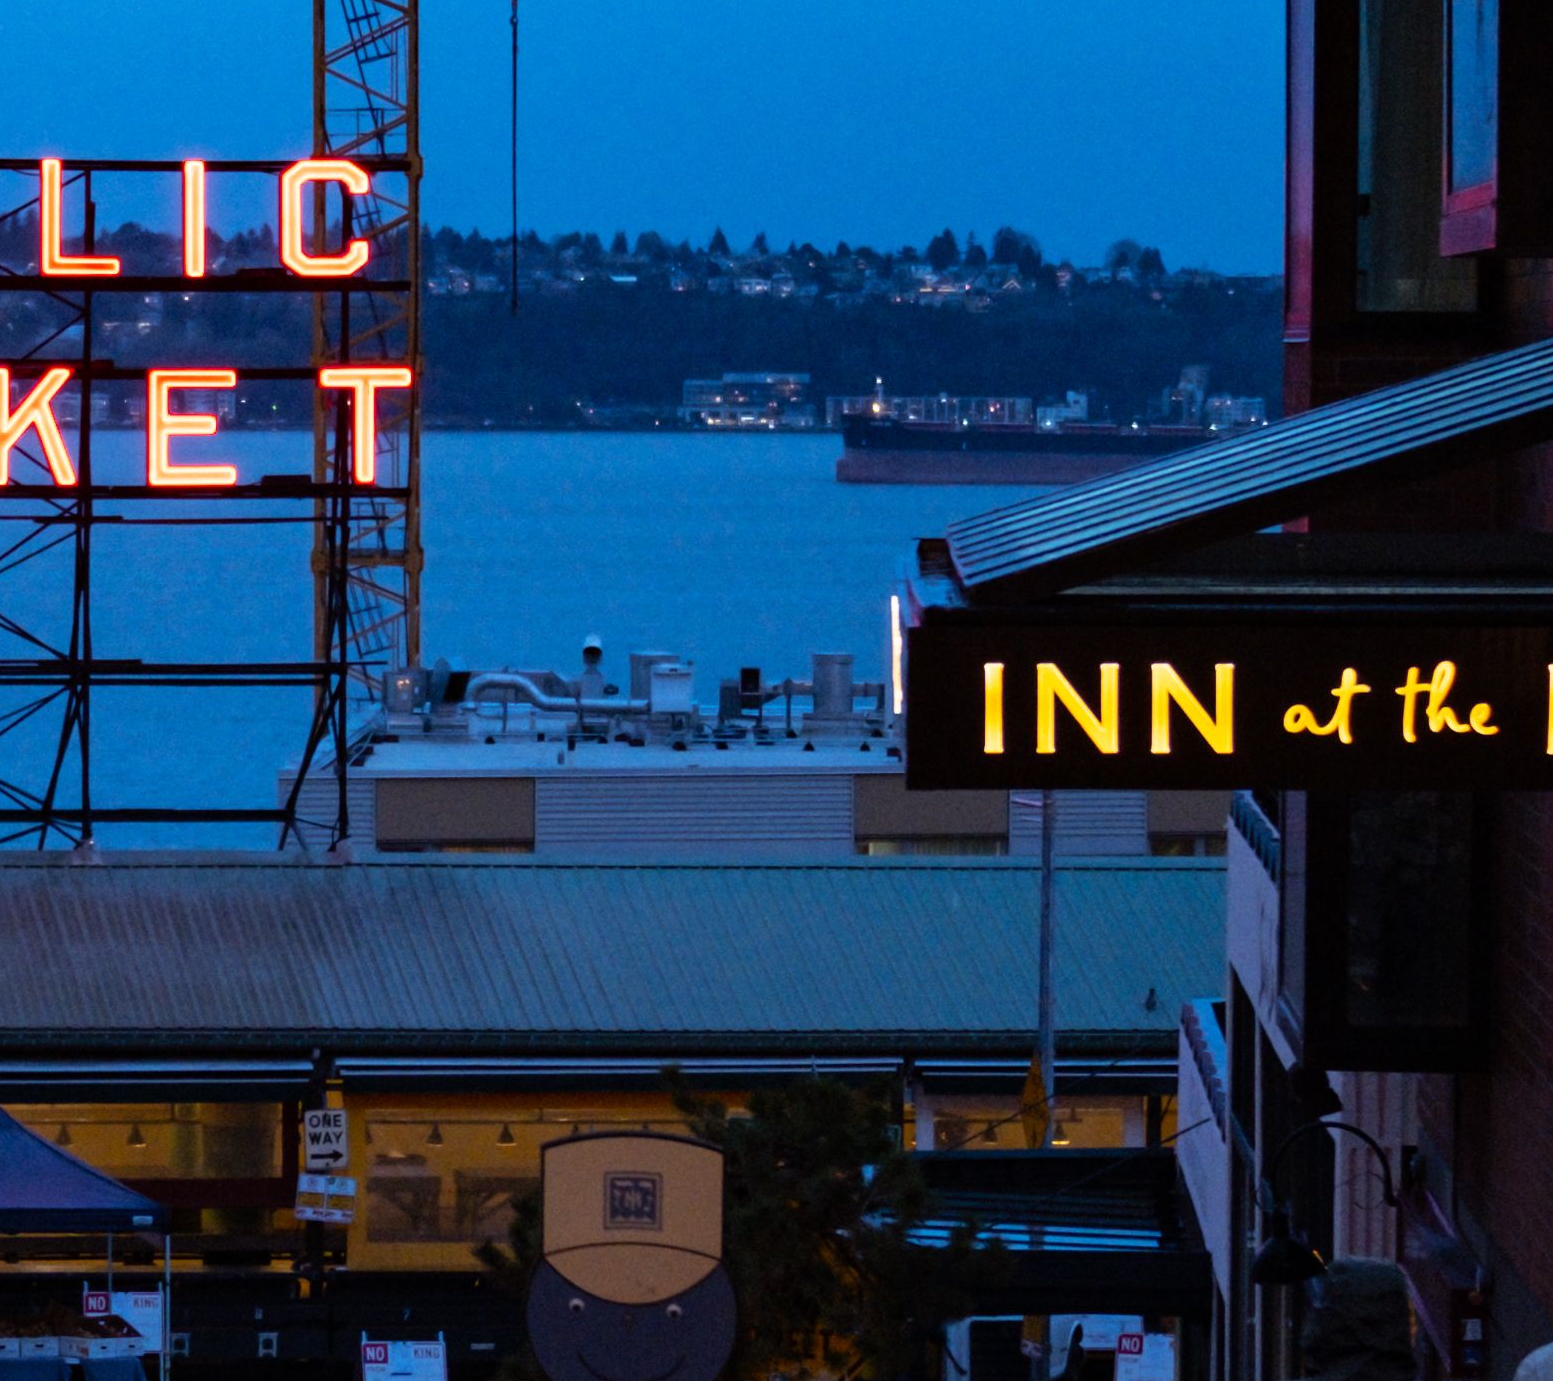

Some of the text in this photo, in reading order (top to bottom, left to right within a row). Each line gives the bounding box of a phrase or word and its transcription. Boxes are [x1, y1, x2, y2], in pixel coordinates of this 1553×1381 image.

[983, 662, 1234, 754] INN
[1283, 667, 1372, 744] at
[1395, 660, 1500, 743] the
[309, 1114, 342, 1128] ONE
[309, 1131, 343, 1145] WAY
[88, 1296, 106, 1311] NO
[1121, 1337, 1141, 1353] NO
[366, 1347, 385, 1361] NO
